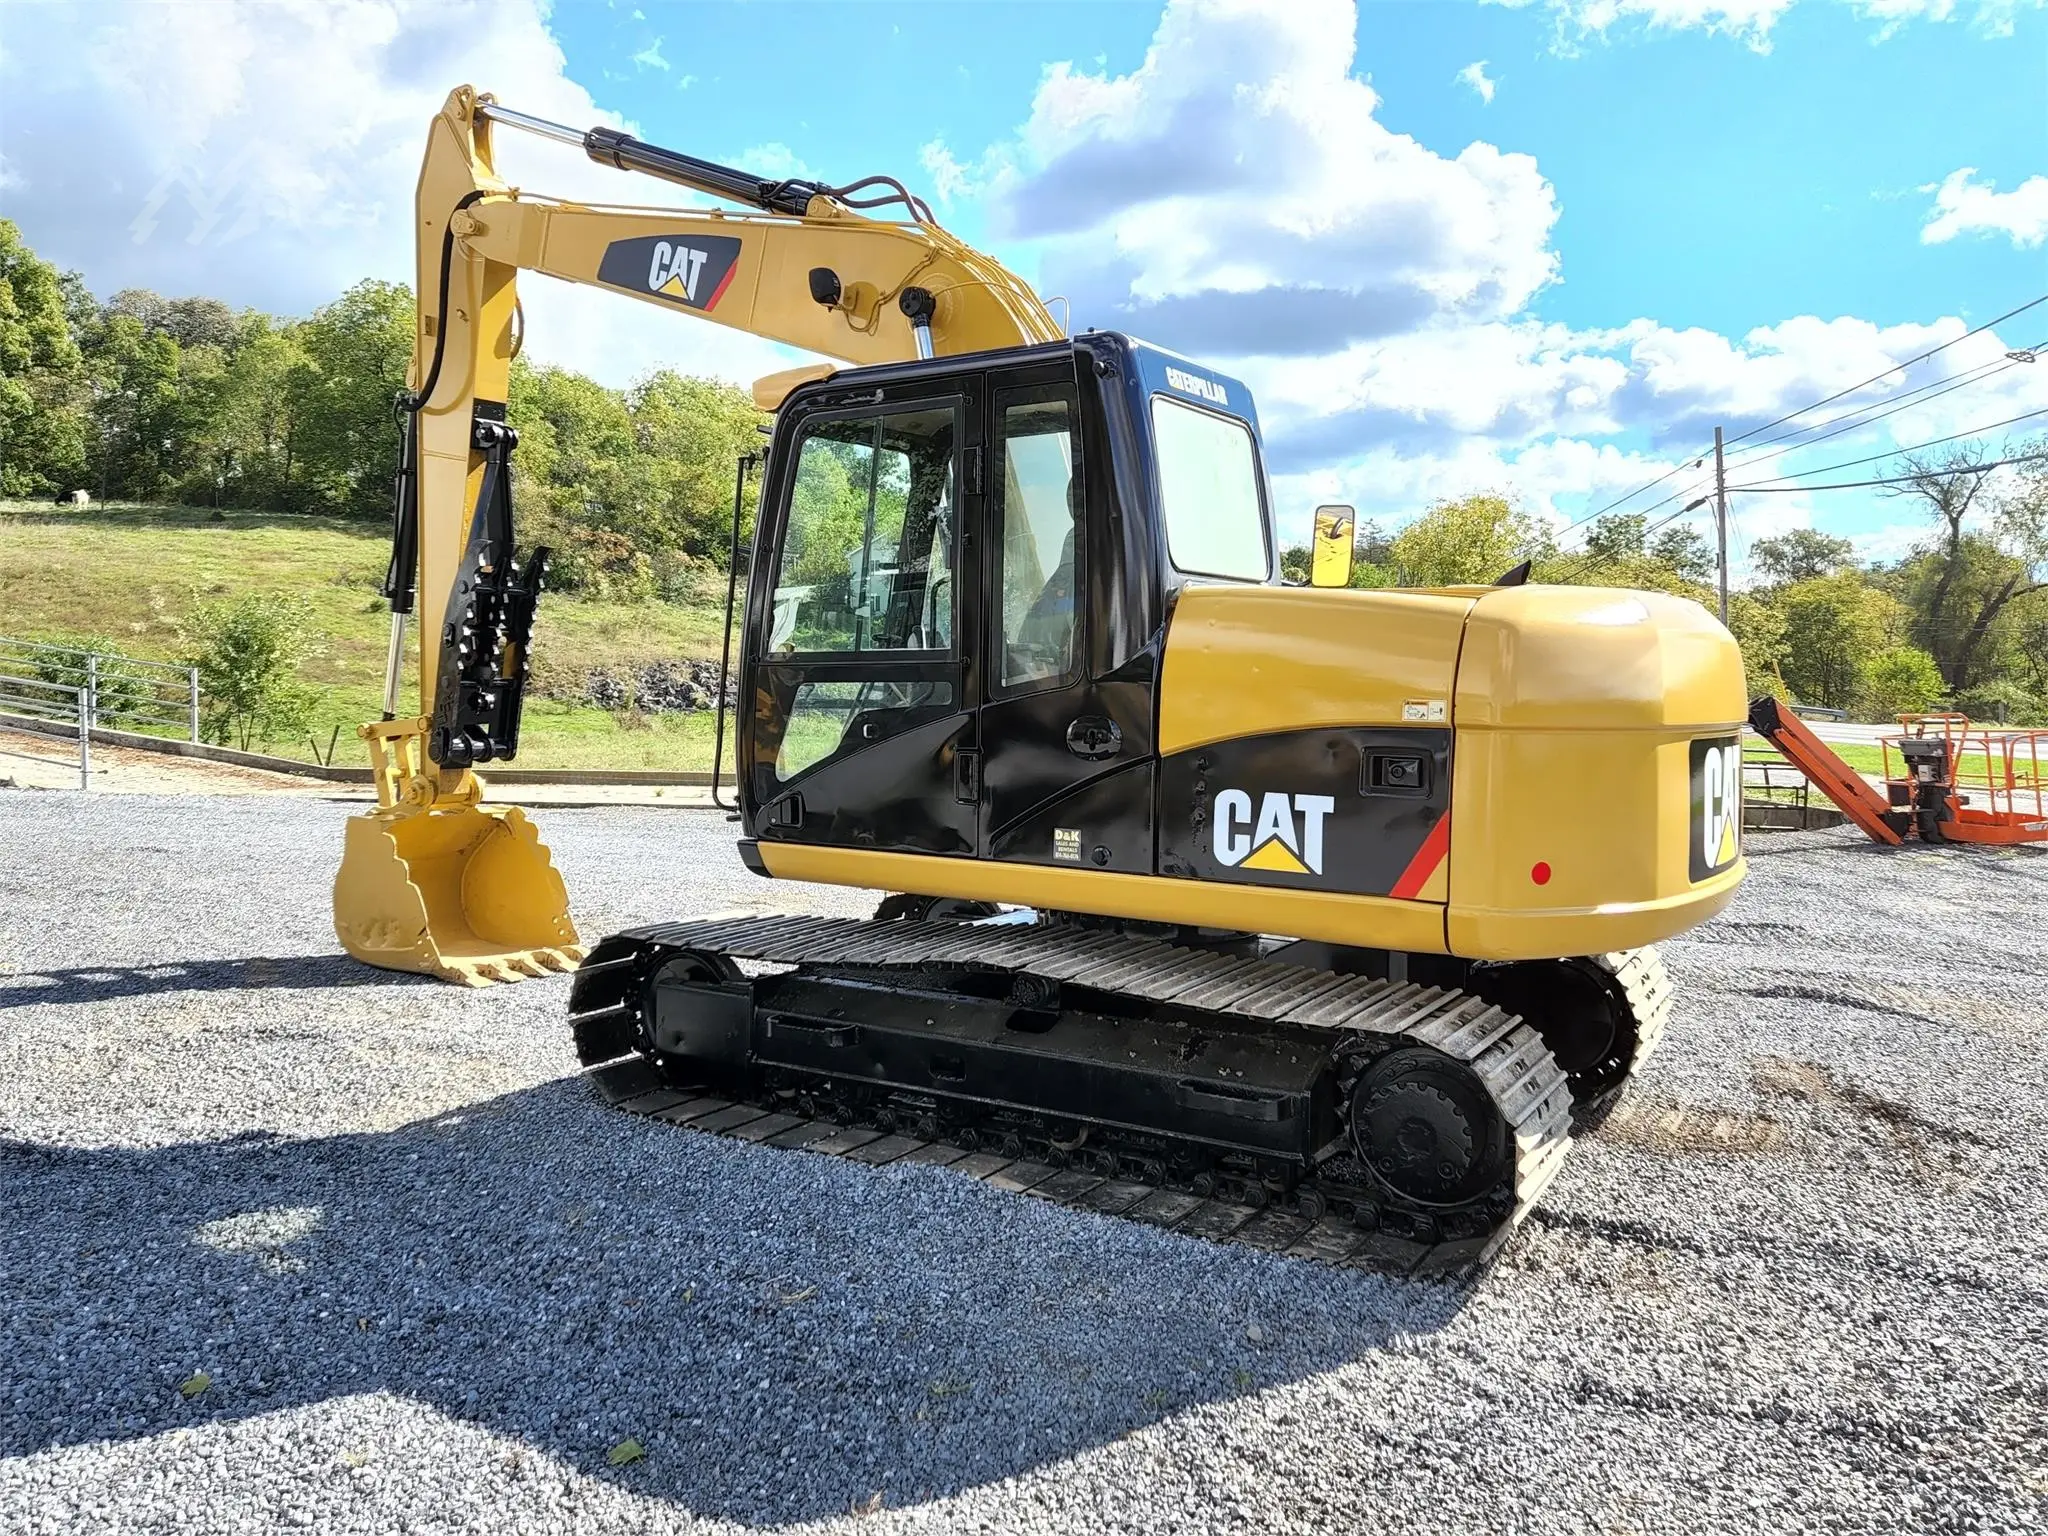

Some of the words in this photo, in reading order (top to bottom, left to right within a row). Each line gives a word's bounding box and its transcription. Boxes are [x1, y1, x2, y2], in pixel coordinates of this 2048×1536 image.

[648, 241, 708, 302] CAT
[1165, 365, 1228, 406] CATERPILLAR
[1055, 829, 1080, 841] D&K
[1213, 788, 1335, 876] CAT
